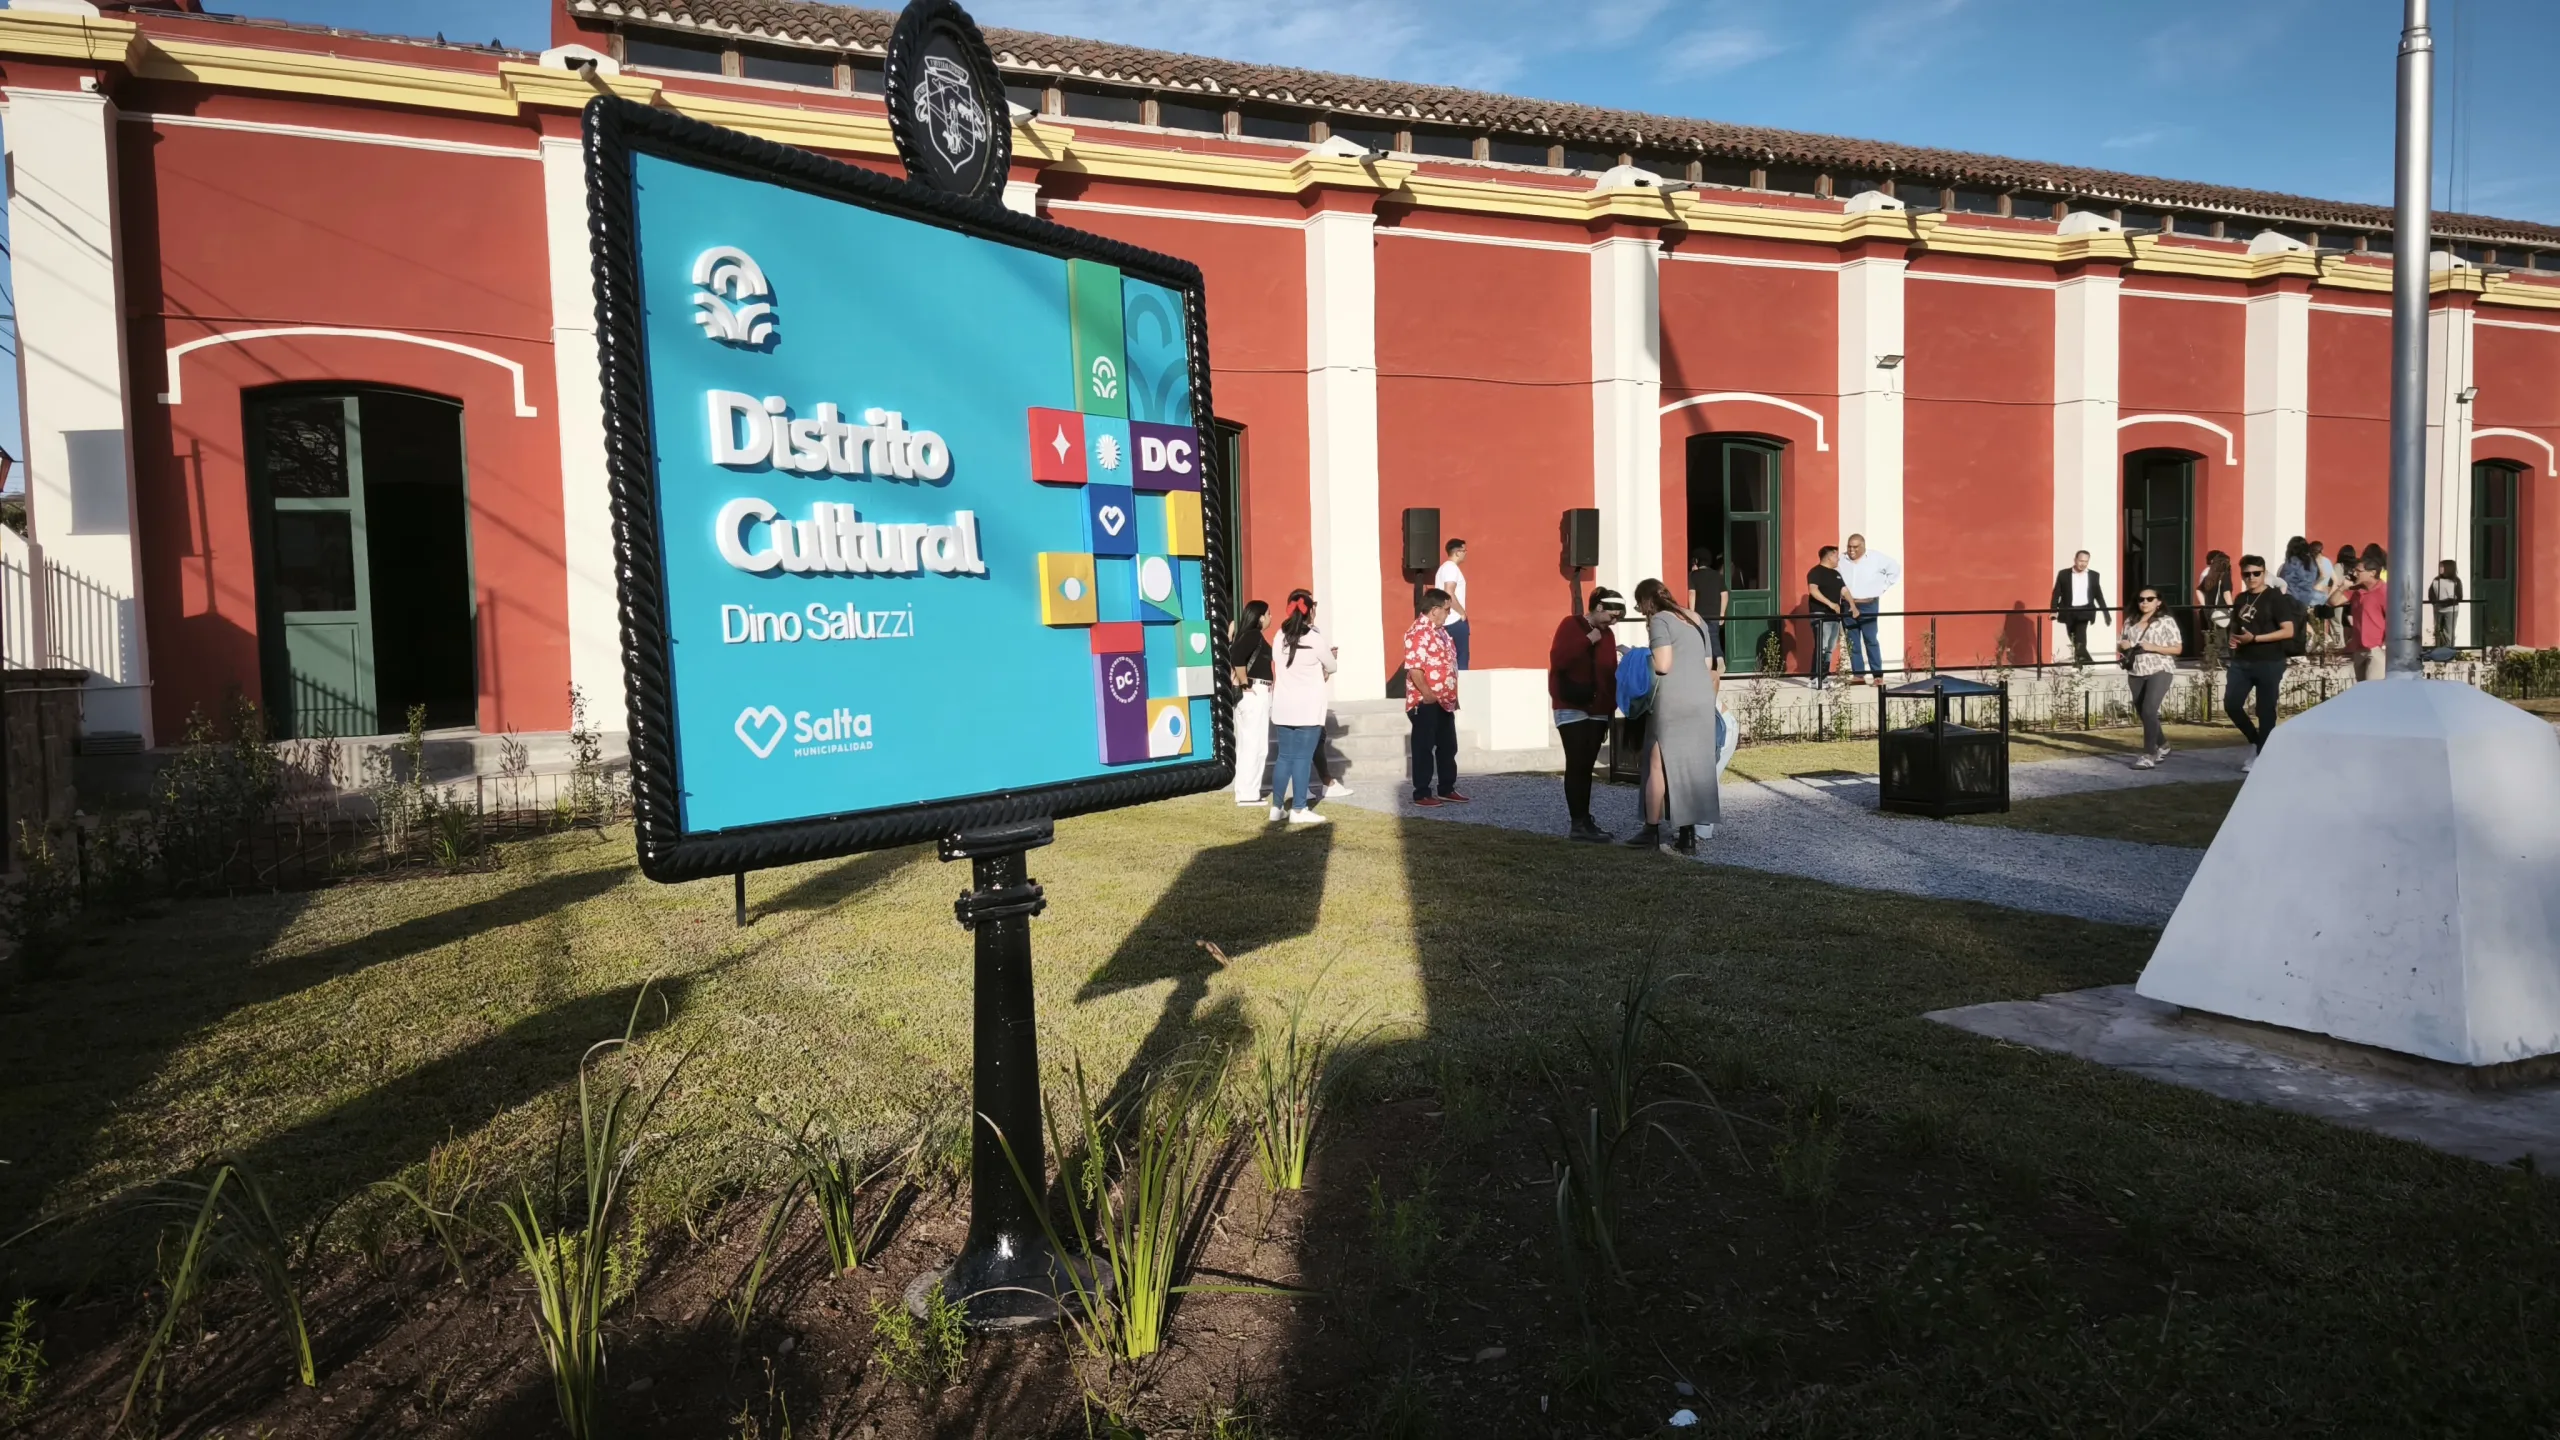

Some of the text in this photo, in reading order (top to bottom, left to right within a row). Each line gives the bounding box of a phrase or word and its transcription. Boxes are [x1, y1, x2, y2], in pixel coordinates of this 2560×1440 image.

[707, 389, 950, 480] Distrito
[1140, 436, 1193, 474] DC
[715, 497, 985, 574] Cultural
[721, 602, 915, 644] Dino Saluzzi
[1115, 671, 1134, 690] DC
[794, 707, 873, 743] Salta
[794, 741, 874, 757] MUNICIPALIDAD
